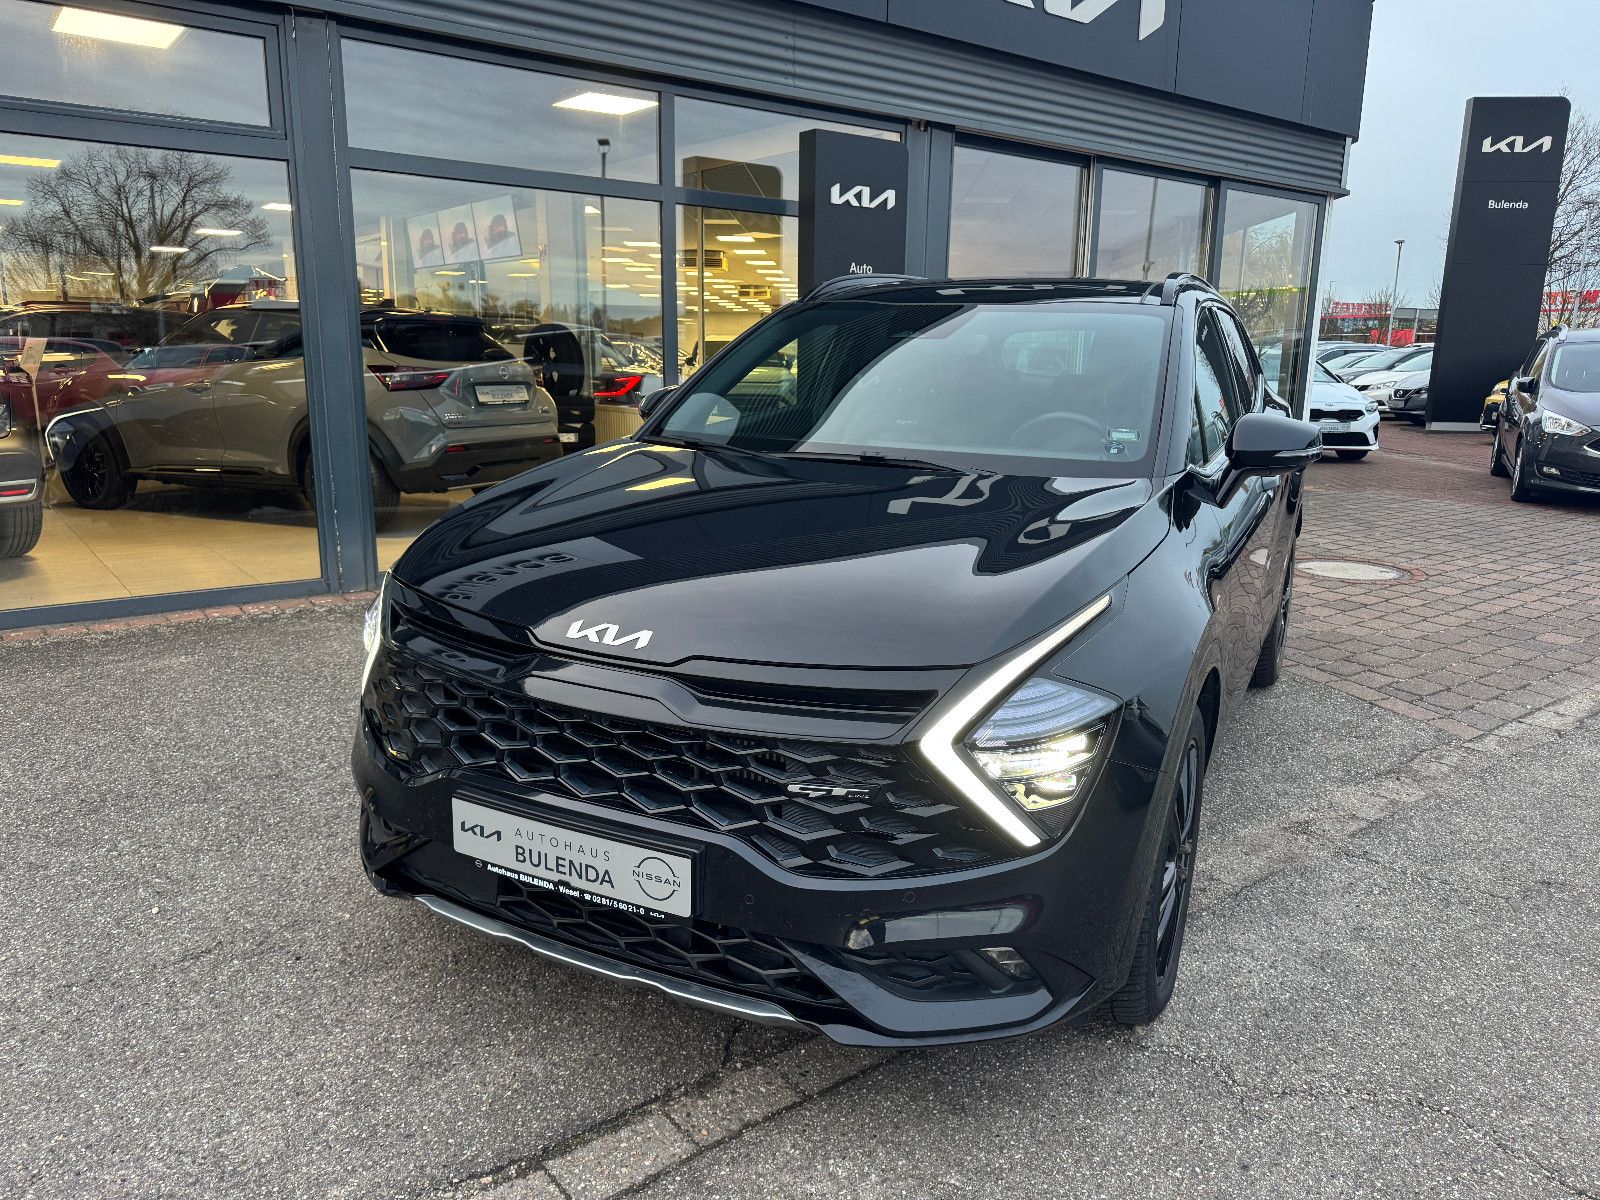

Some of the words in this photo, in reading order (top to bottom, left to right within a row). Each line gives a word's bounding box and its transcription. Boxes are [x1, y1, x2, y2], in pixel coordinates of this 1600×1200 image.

[1481, 135, 1553, 154] KIA
[830, 182, 896, 210] KIA
[1487, 199, 1529, 209] Bulenda
[849, 261, 873, 274] Auto
[566, 619, 653, 650] KIA
[460, 820, 501, 842] KIA
[514, 827, 611, 862] AUTOHAUS
[514, 844, 615, 889] BULENDA
[632, 869, 681, 889] NISSAN
[487, 863, 519, 880] Autohaus
[519, 873, 554, 890] BULENDA
[559, 885, 580, 898] Wesel
